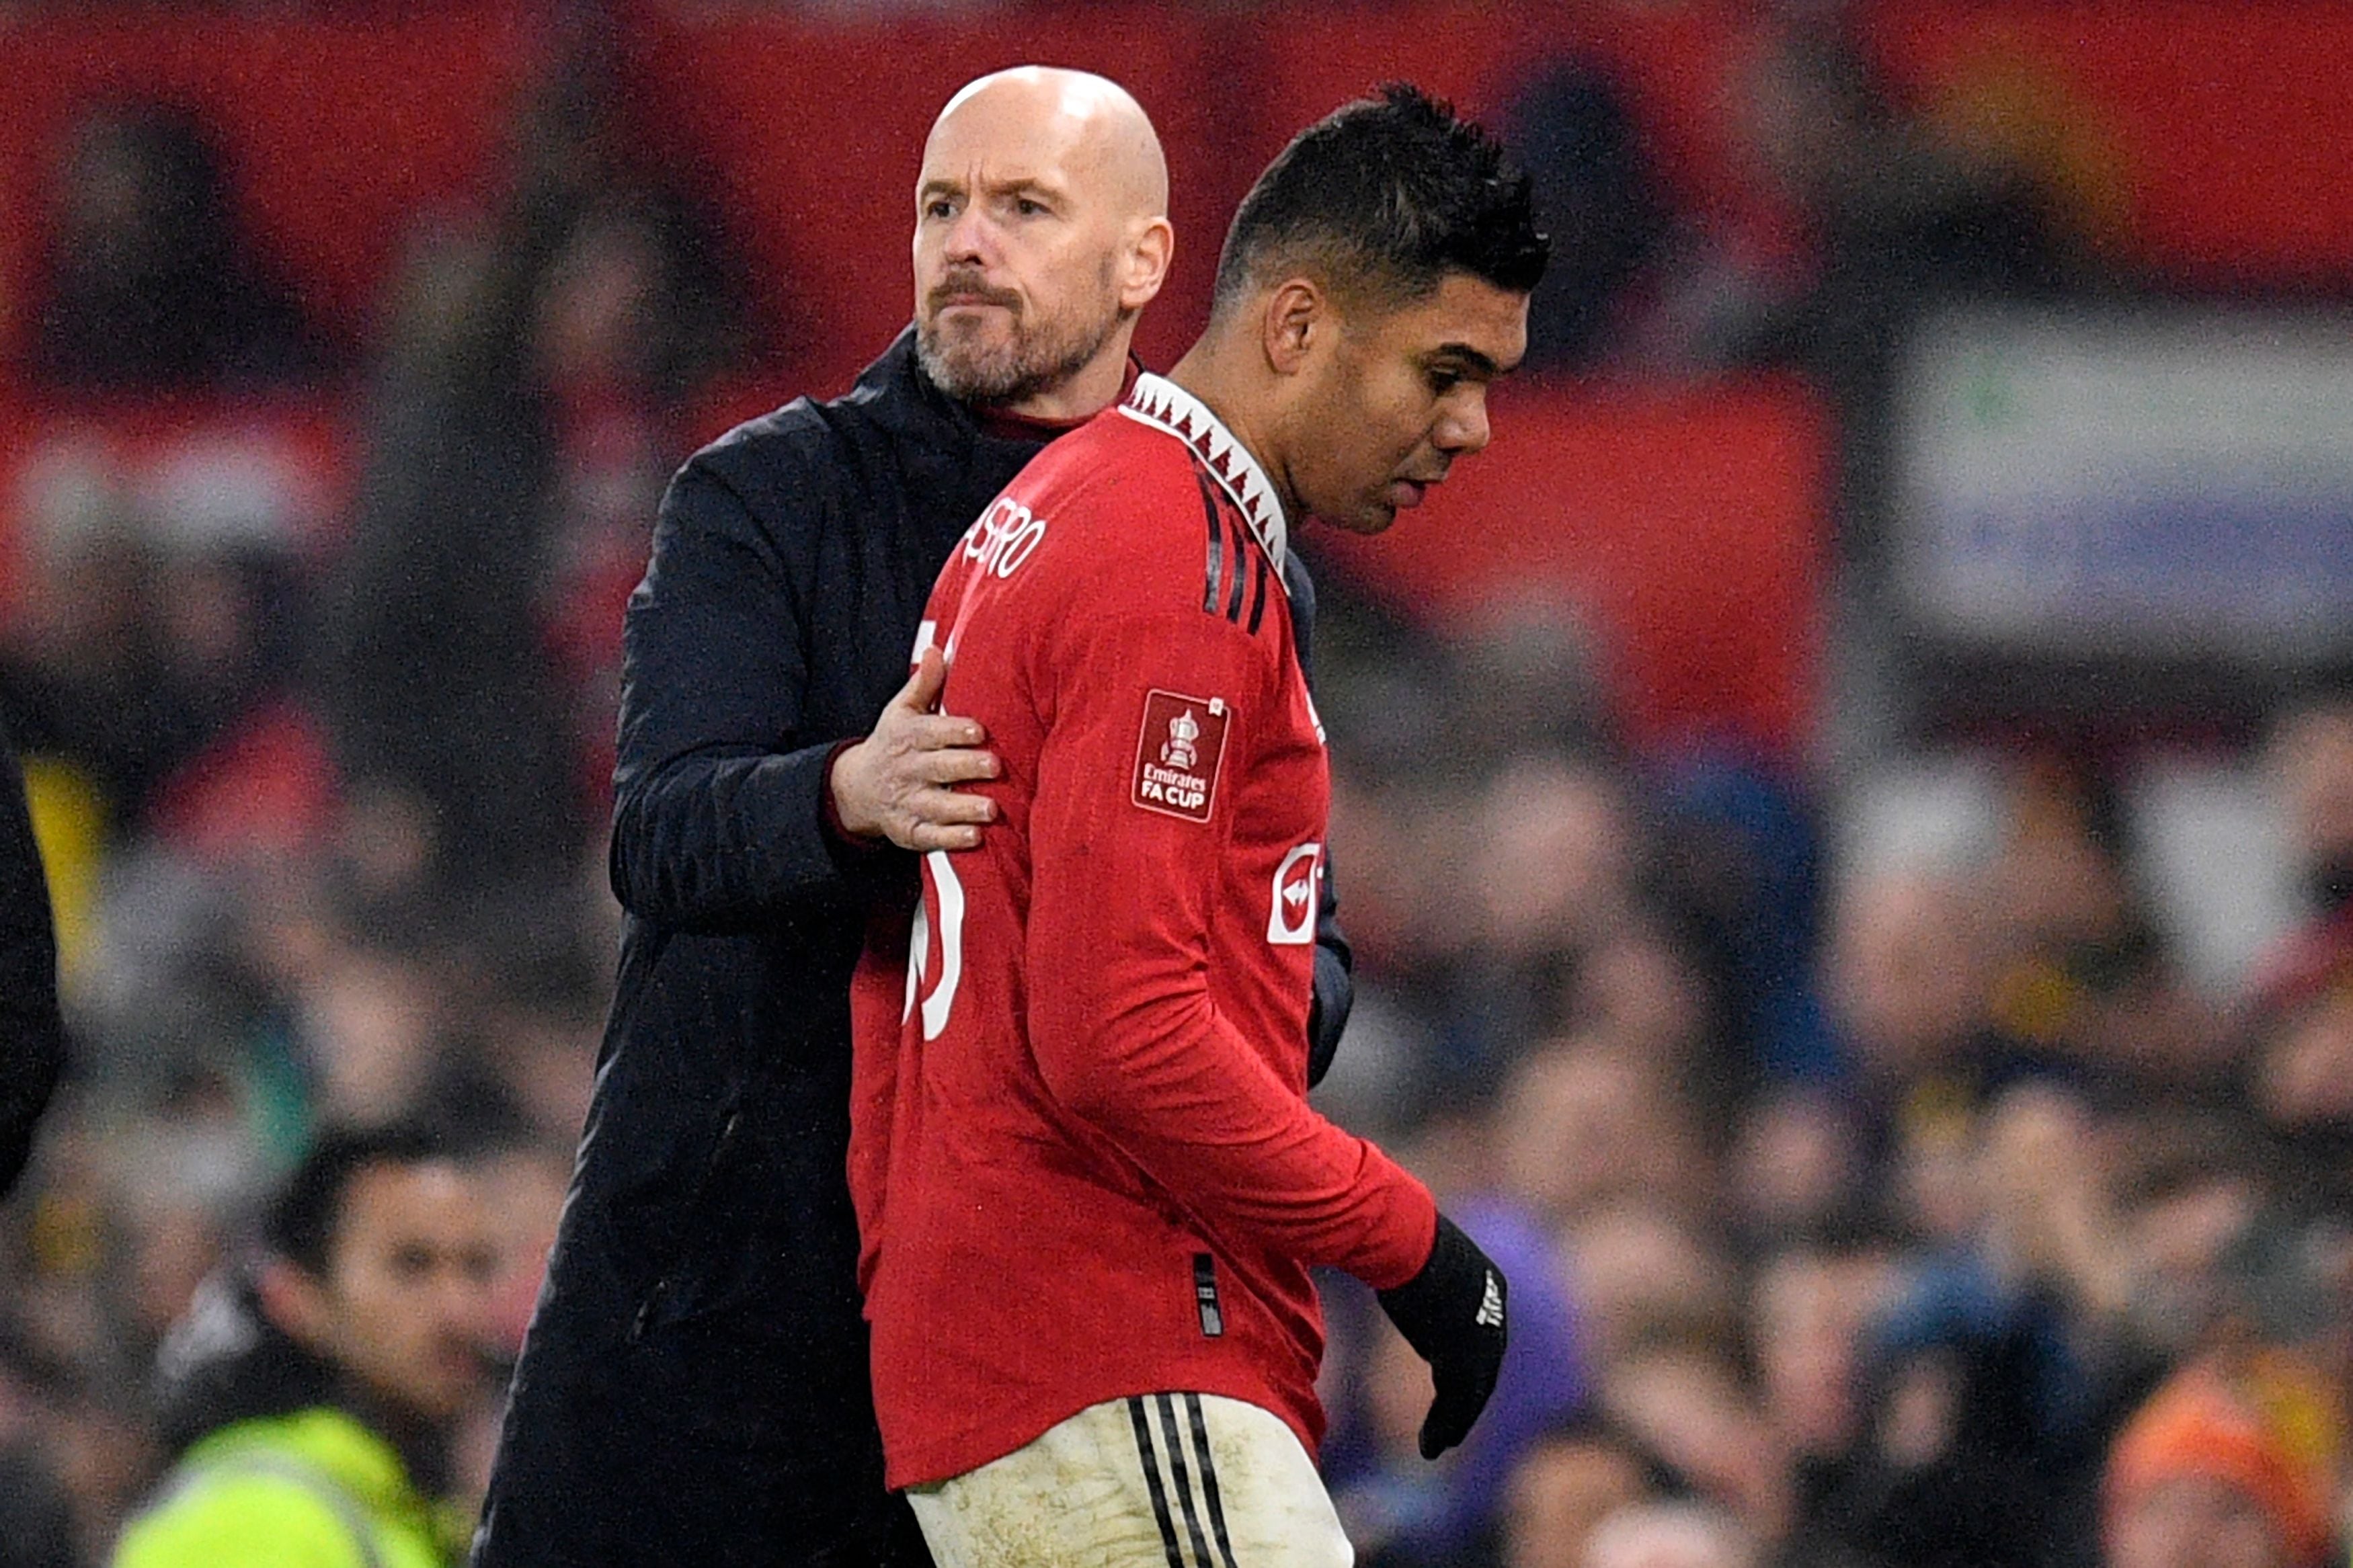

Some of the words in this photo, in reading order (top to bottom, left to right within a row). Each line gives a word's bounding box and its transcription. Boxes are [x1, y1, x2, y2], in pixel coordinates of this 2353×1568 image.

[1144, 763, 1206, 792] Emirates
[1142, 780, 1164, 801] FA
[1165, 786, 1205, 809] CUP
